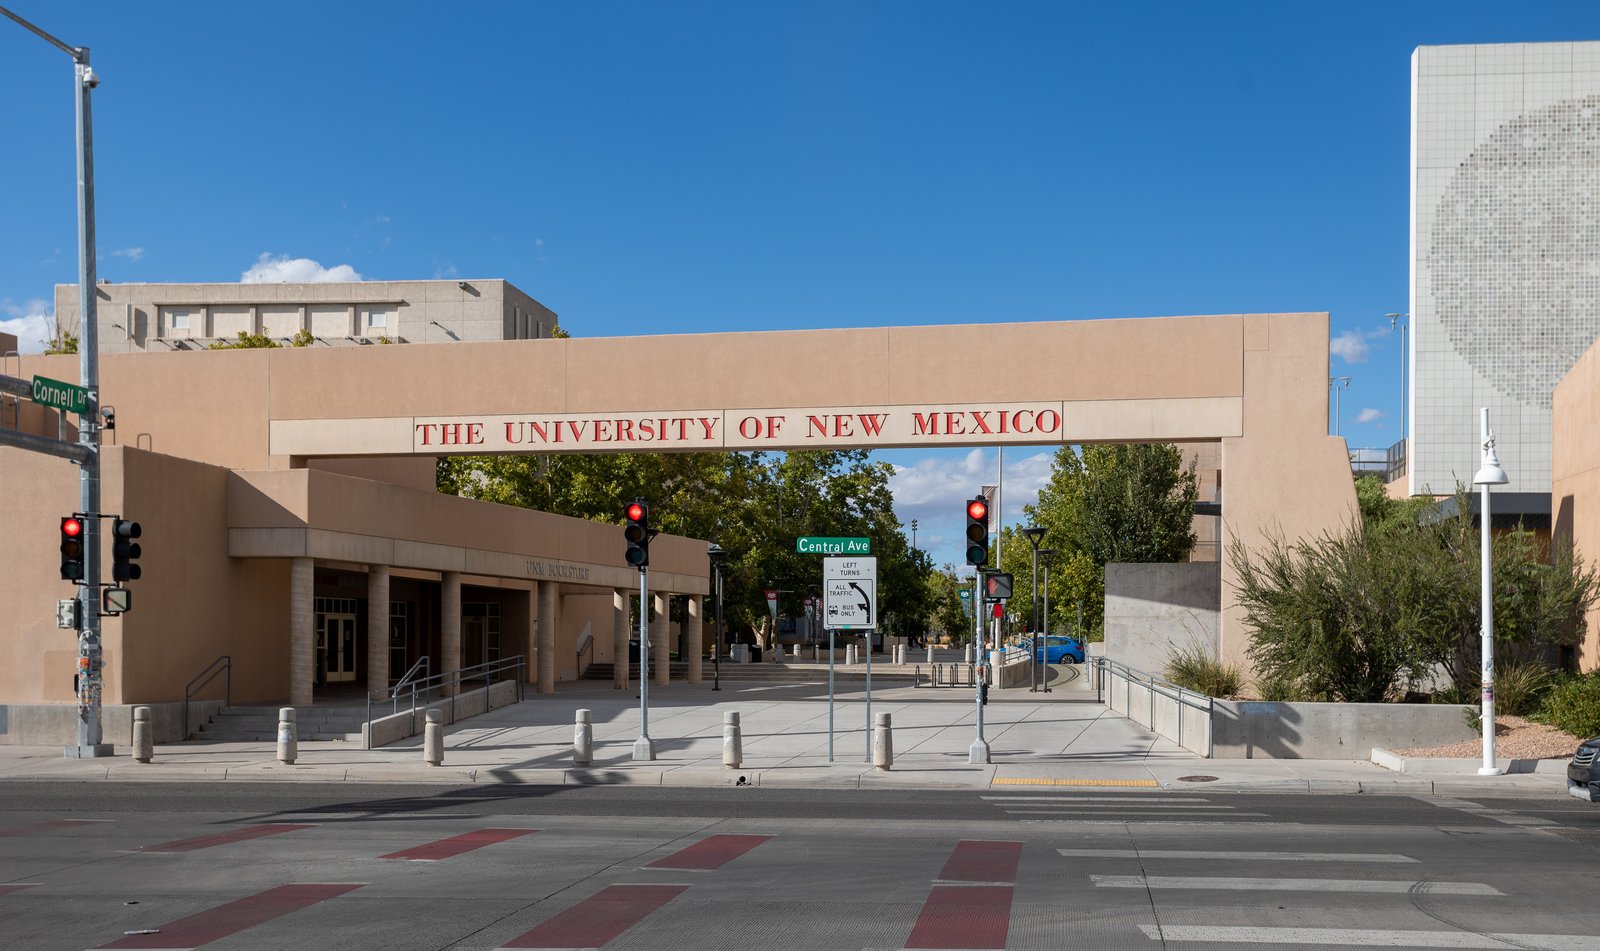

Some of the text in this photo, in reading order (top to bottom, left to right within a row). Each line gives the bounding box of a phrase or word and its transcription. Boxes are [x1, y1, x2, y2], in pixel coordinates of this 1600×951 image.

[33, 380, 87, 408] Cornell Dr
[415, 409, 1061, 446] THE UNIVERSITY OF NEW MEXICO
[799, 538, 868, 552] Central Ave
